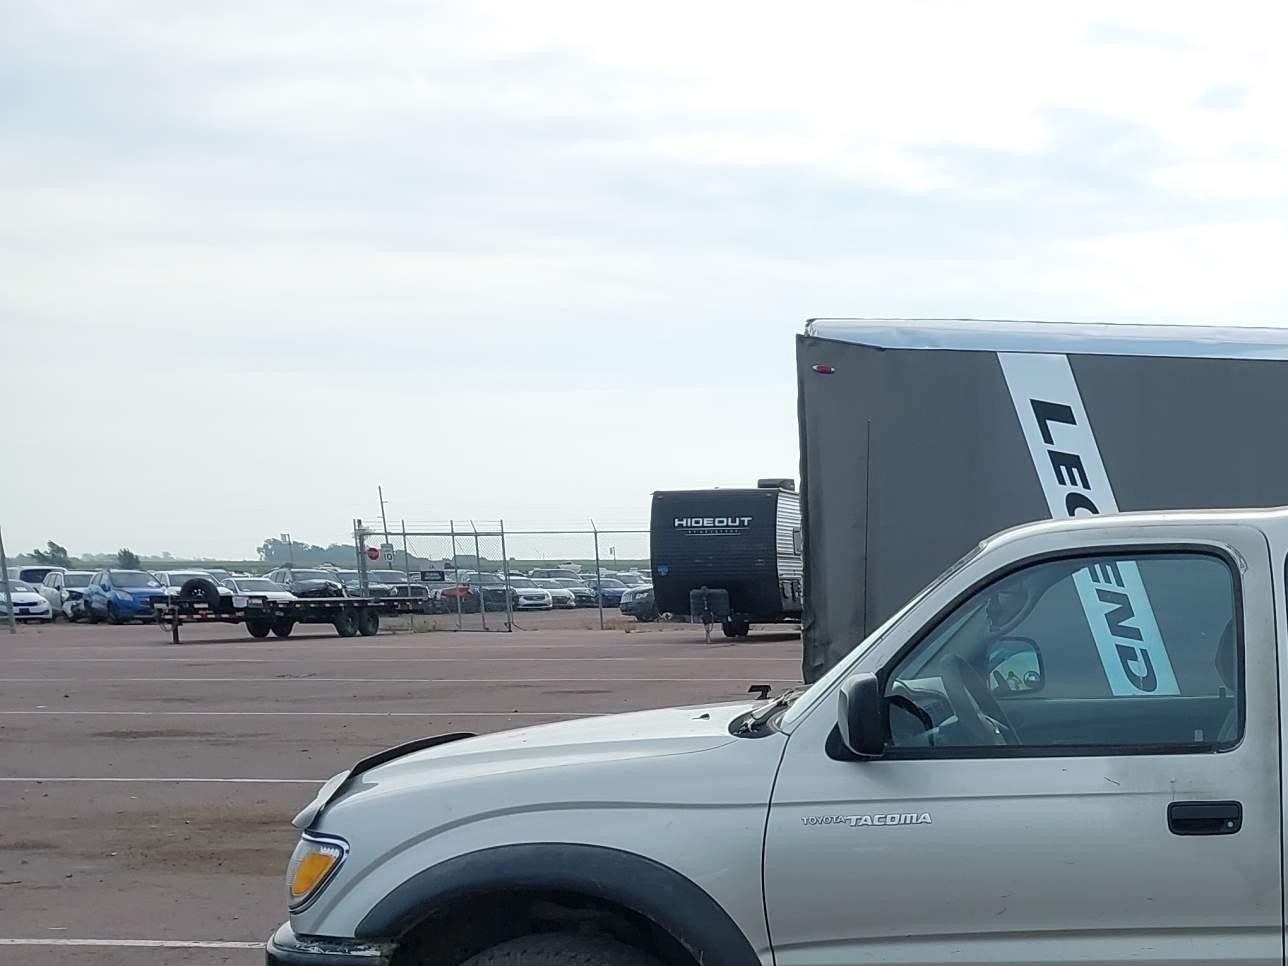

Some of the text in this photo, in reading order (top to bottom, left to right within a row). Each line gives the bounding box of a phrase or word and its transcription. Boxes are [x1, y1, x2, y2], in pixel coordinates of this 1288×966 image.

[674, 517, 753, 527] HIDEOUT
[801, 812, 933, 827] TOYOTA TACOMA
